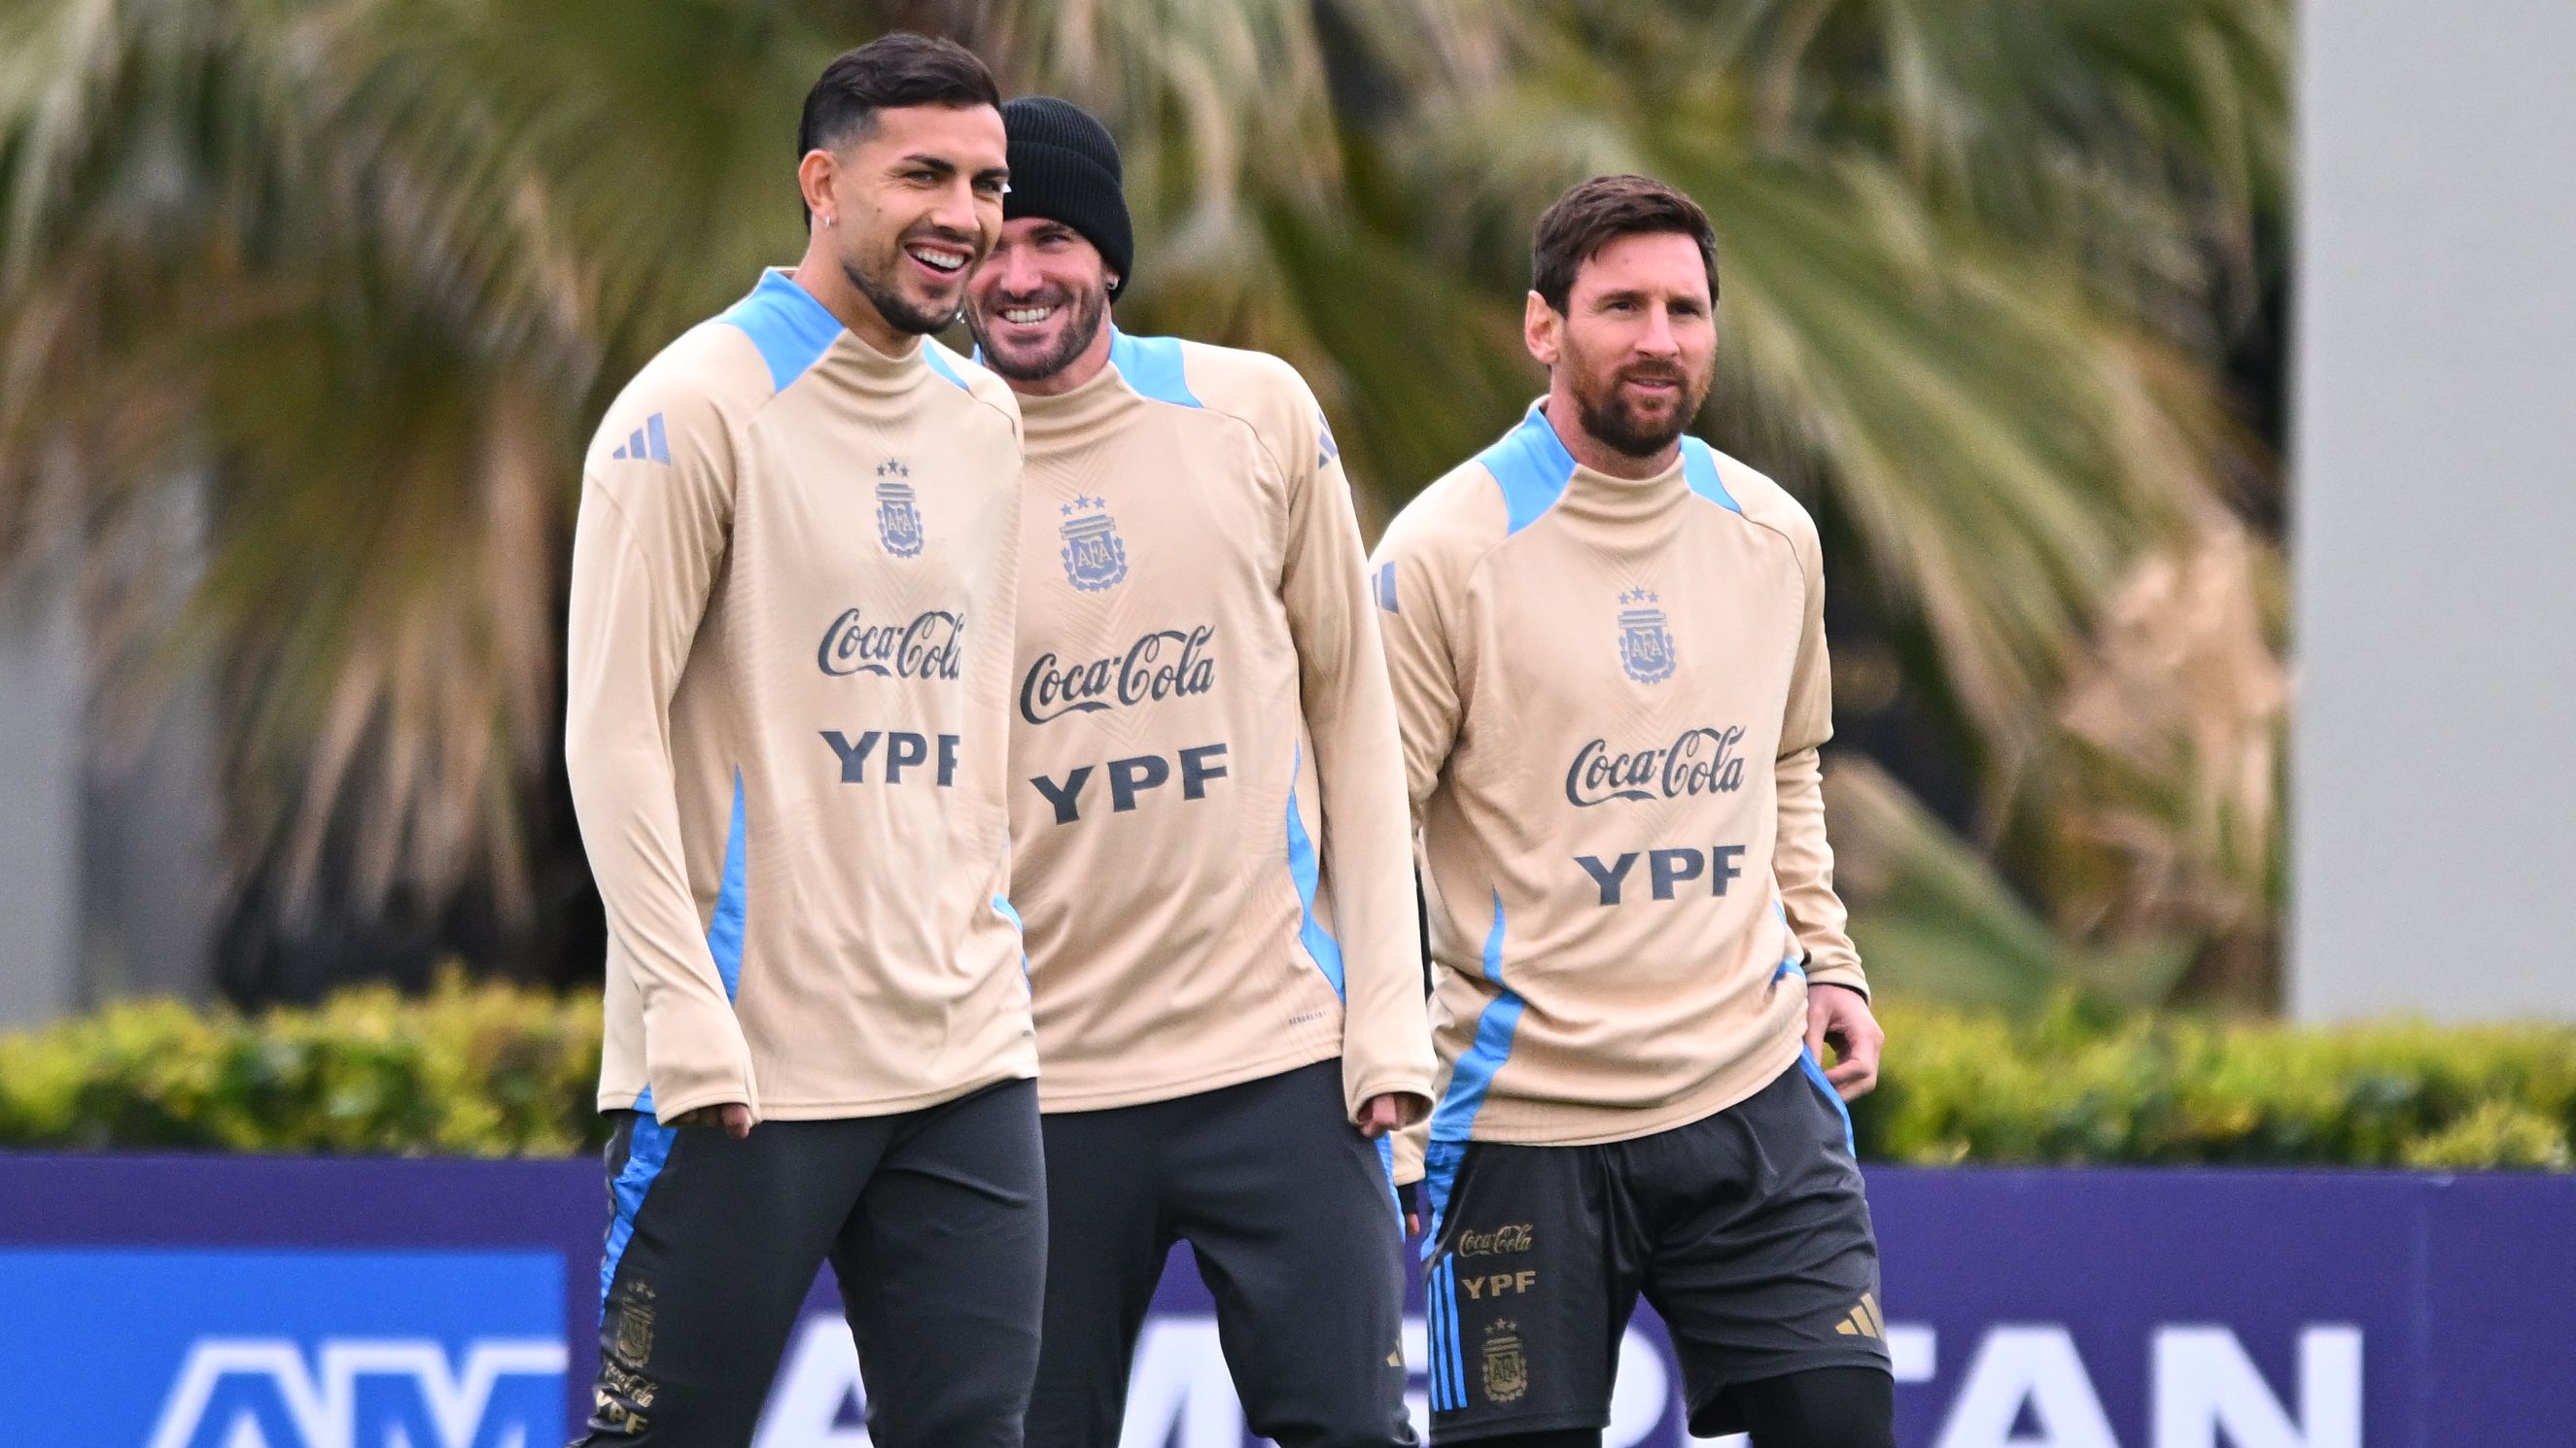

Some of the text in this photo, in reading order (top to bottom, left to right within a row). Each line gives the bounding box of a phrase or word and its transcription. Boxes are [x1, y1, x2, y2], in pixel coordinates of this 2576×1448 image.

[1076, 534, 1113, 569] AFA
[1020, 625, 1215, 725] Coca-Cola
[818, 731, 960, 787] YPF
[1028, 742, 1229, 825] YPF
[1566, 725, 1747, 808] Coca-Cola
[1573, 845, 1747, 907] YPF
[1459, 1224, 1534, 1258] Coca-Cola
[1462, 1270, 1537, 1299] YPF
